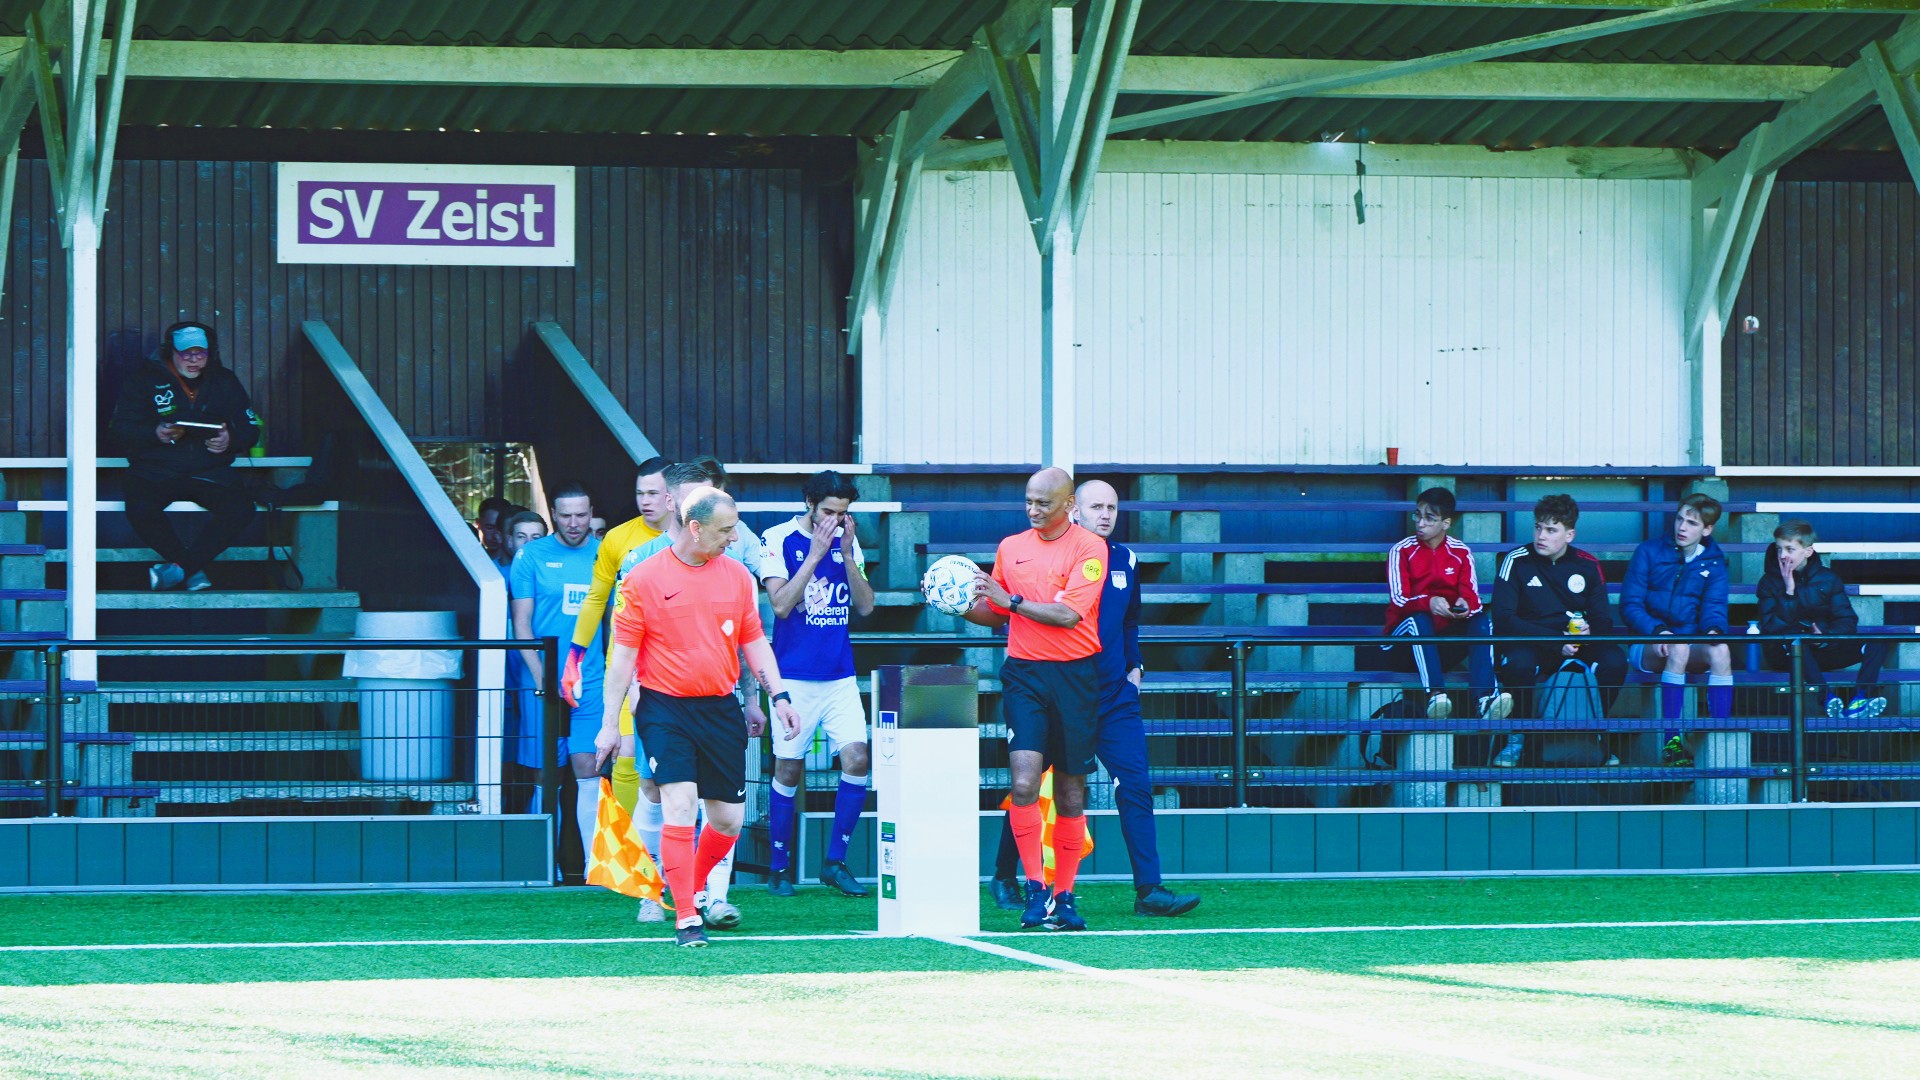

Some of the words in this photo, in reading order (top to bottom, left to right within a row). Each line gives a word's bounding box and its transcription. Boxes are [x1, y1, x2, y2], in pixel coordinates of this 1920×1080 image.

[309, 188, 384, 239] SV
[406, 189, 544, 241] Zeist
[803, 582, 849, 604] PVC
[804, 603, 849, 616] Vloeren
[805, 614, 849, 628] Kopen.nl
